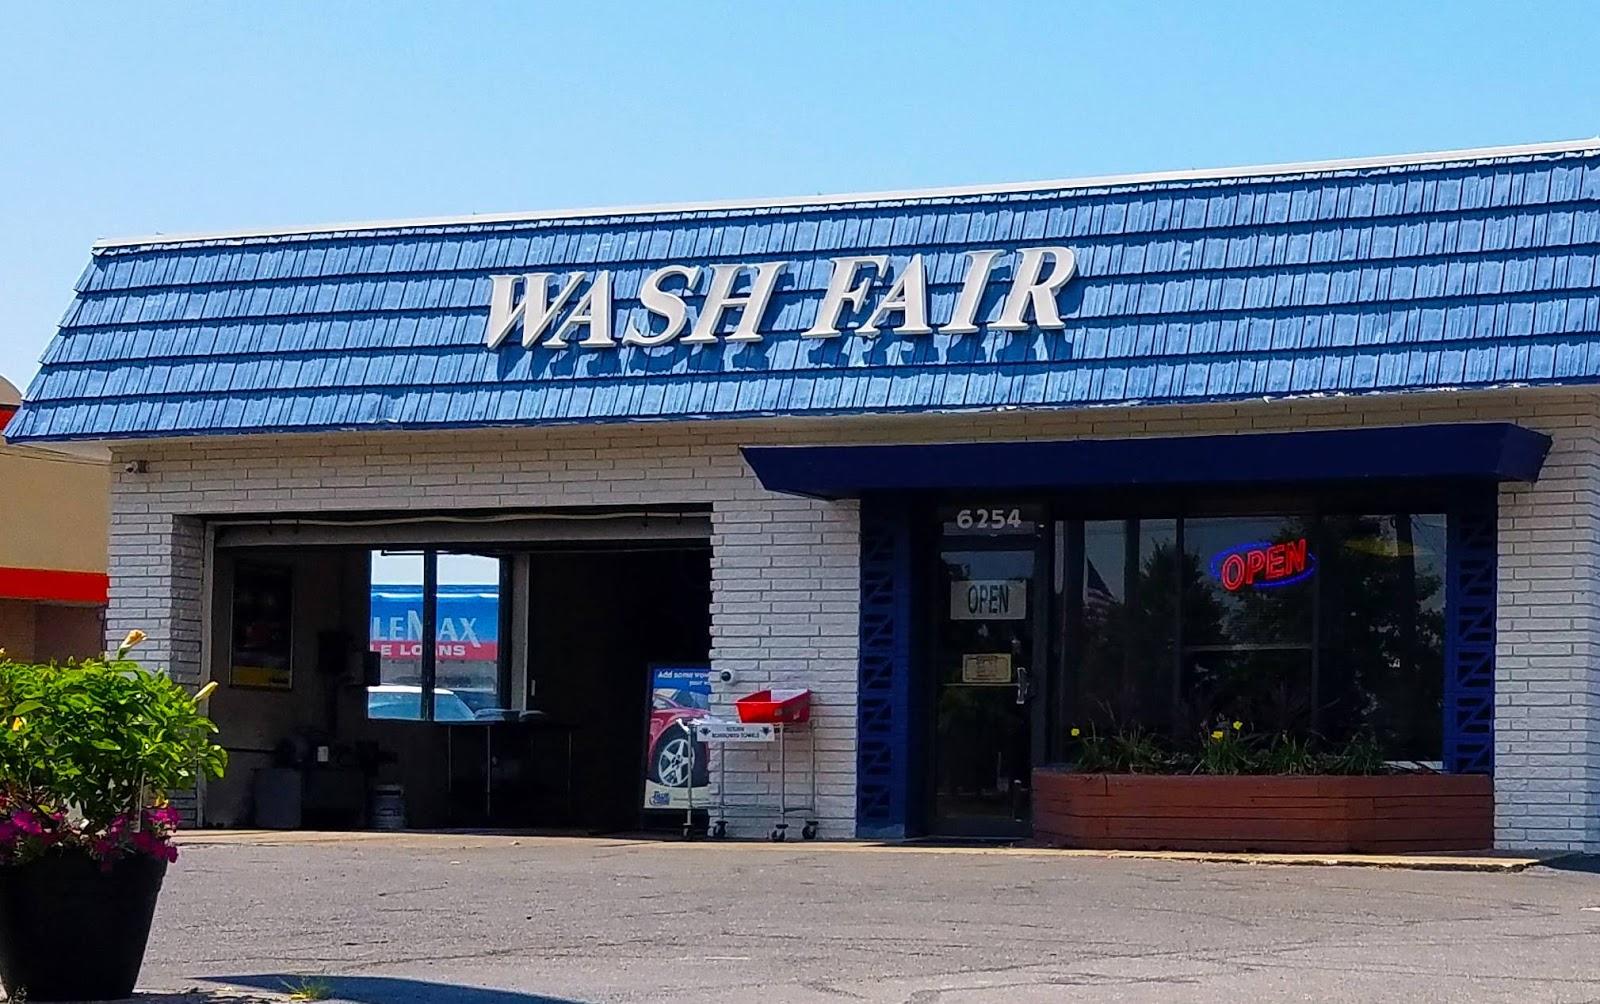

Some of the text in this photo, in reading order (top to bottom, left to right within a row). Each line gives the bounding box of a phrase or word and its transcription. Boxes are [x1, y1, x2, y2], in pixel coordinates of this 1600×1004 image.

[487, 246, 1078, 349] WASH FAIR
[957, 509, 1022, 529] 6254
[1222, 538, 1306, 591] OPEN
[968, 584, 1009, 614] OPEN
[400, 644, 466, 656] LONS
[658, 670, 673, 679] Add
